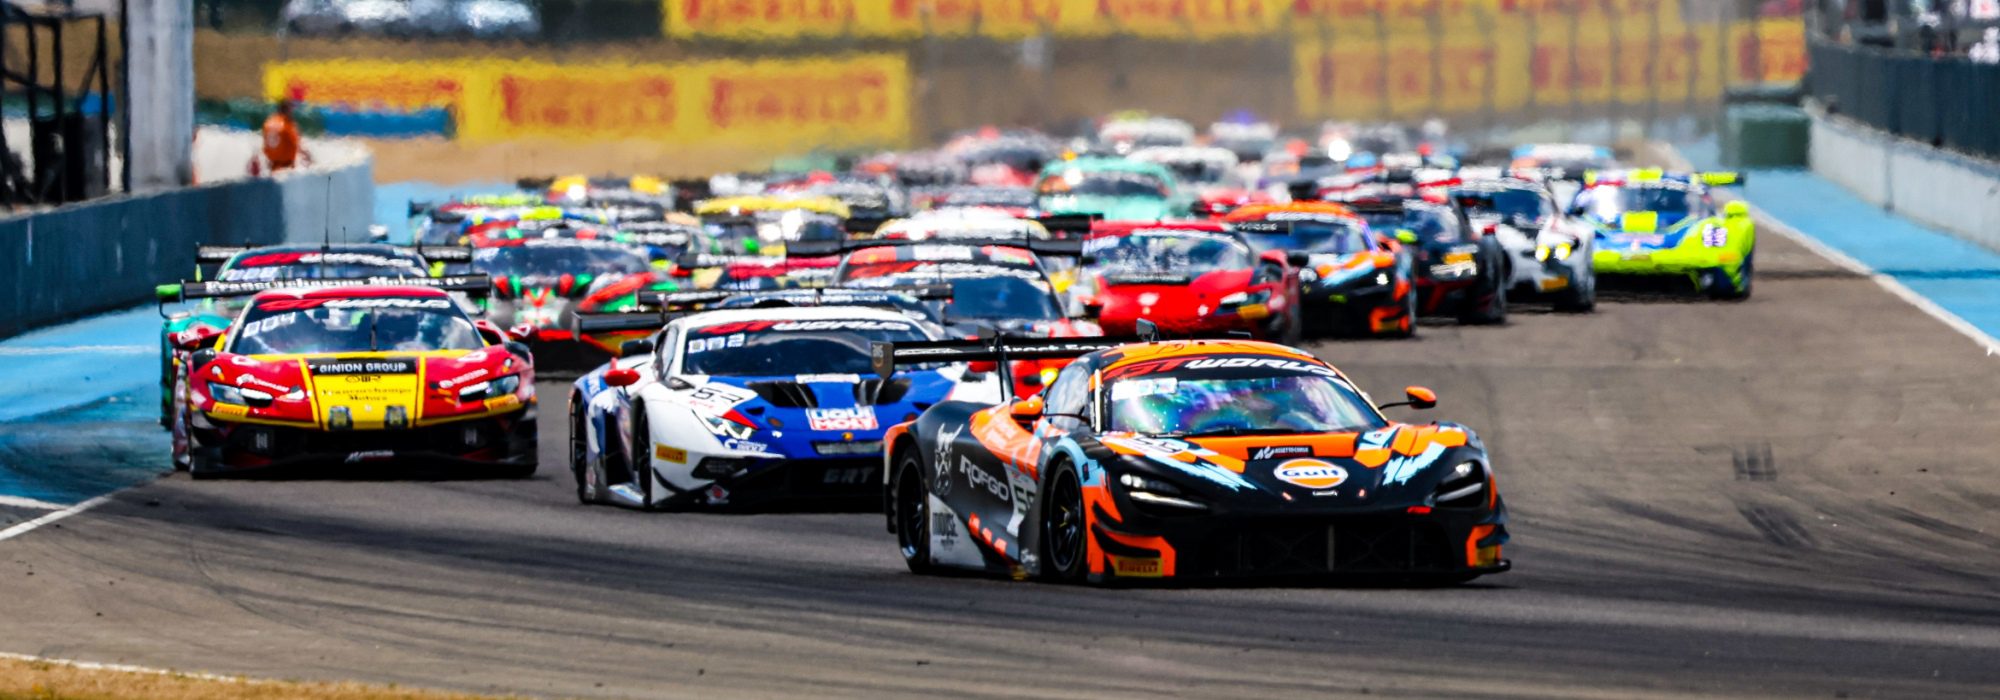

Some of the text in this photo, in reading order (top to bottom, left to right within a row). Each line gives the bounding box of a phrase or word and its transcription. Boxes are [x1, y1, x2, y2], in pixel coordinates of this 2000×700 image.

[319, 362, 408, 373] GINION GROUP
[808, 404, 874, 419] LIQUI
[813, 418, 876, 431] MOLY
[959, 454, 1010, 502] ROFGO
[1282, 469, 1340, 477] Gulf
